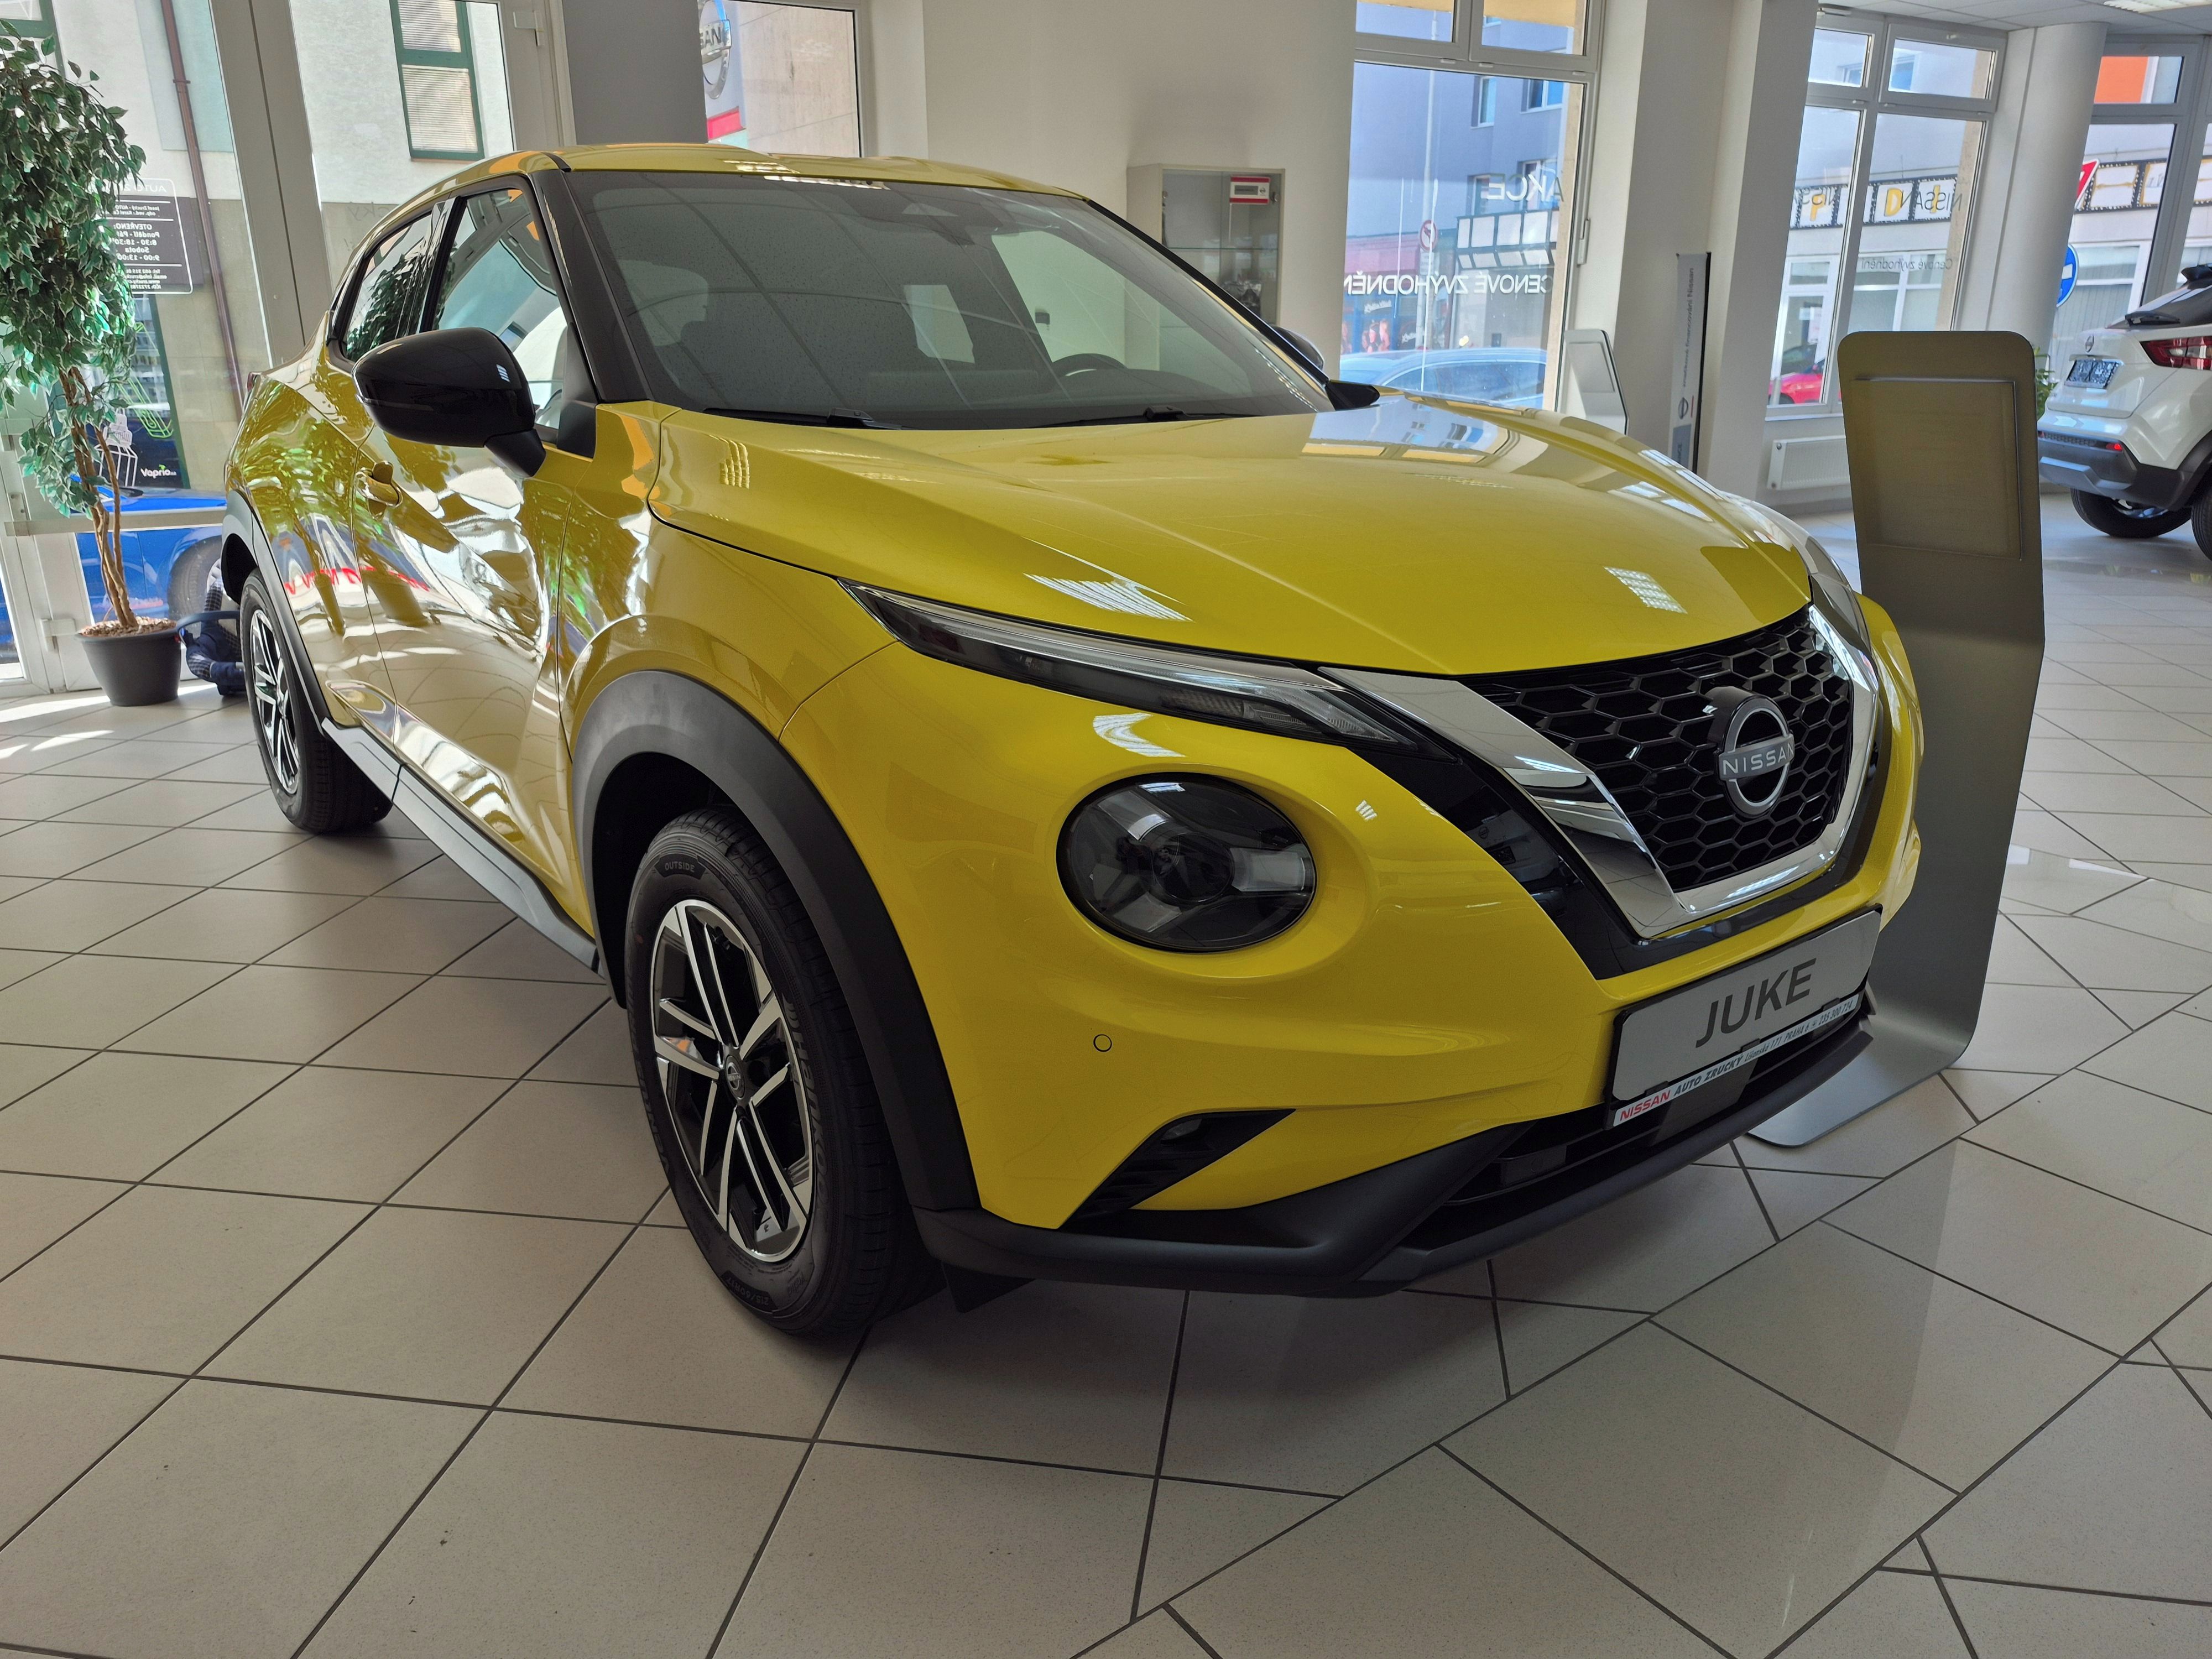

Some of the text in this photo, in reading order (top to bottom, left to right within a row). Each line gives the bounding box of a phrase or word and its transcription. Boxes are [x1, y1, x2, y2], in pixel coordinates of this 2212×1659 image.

[1723, 743, 1794, 775] NISSAN
[665, 861, 695, 873] OUTSIDE
[1695, 957, 1817, 1048] JUKE
[1620, 1090, 1671, 1121] NISSAN
[1674, 1076, 1702, 1096] AUTO
[1783, 1025, 1805, 1043] PRAHA
